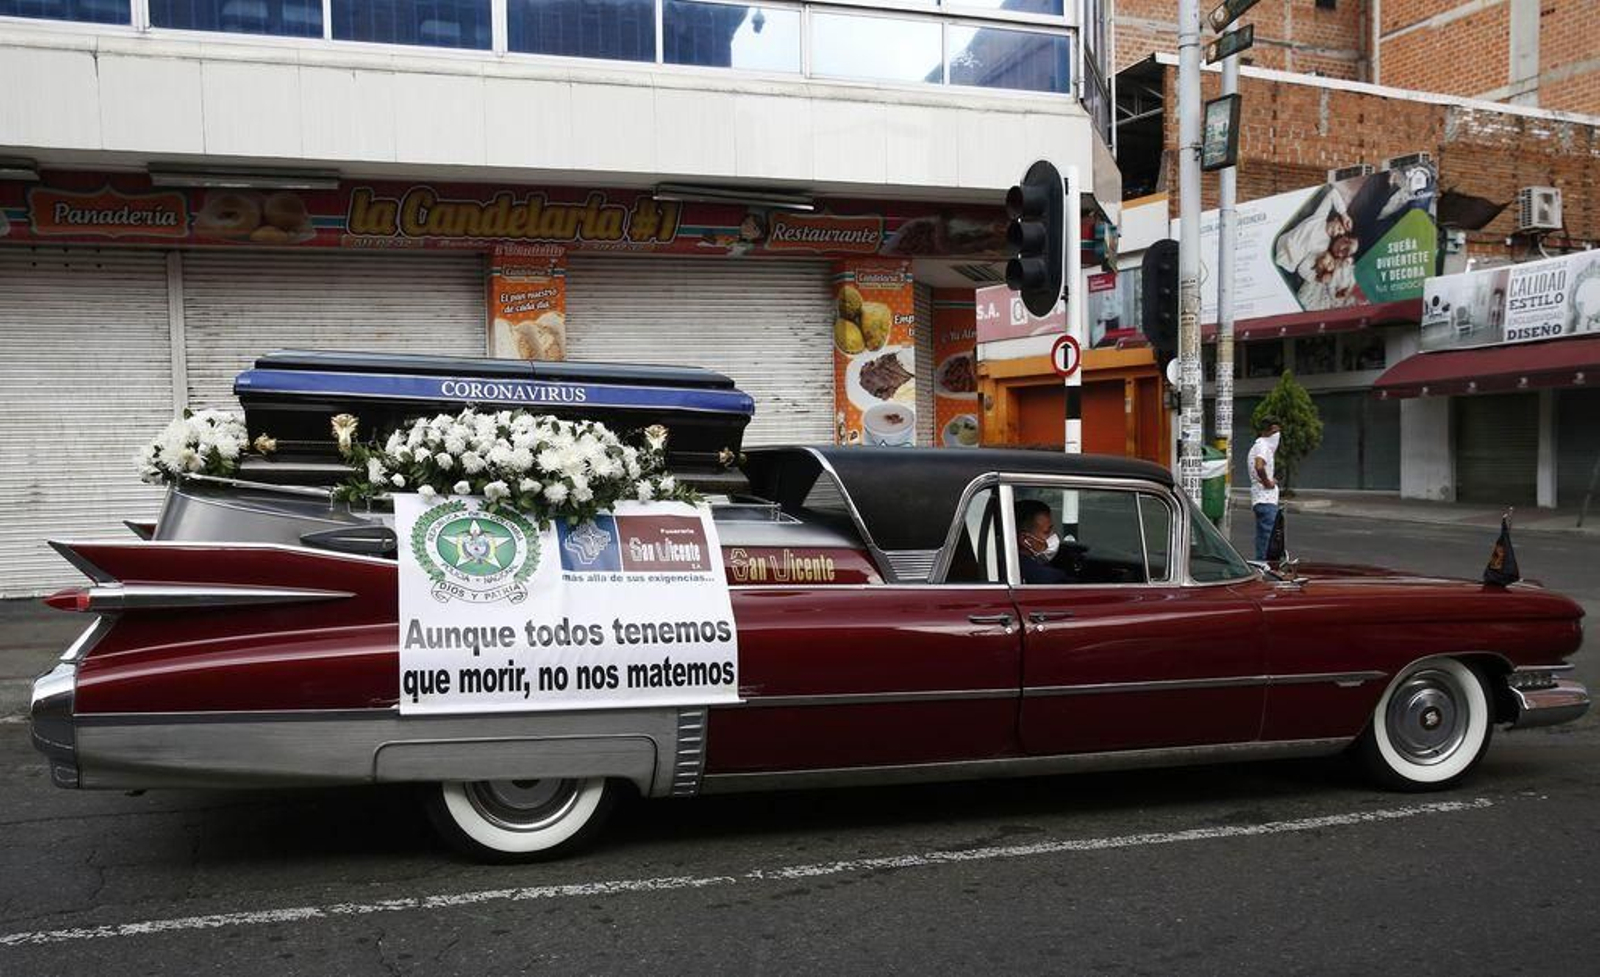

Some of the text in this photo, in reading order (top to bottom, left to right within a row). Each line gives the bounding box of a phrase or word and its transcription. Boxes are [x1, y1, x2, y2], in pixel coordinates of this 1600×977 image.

[54, 202, 178, 226] Panadería
[402, 187, 626, 241] Candelaria
[772, 222, 880, 245] Restaurante
[1387, 237, 1417, 254] SUEÑA
[1381, 265, 1425, 282] Y DECORA
[1510, 269, 1567, 299] CALIDAD
[500, 293, 509, 302] El
[1509, 291, 1565, 310] ESTILO
[1507, 322, 1562, 341] DISEÑO
[441, 380, 586, 402] CORONAVIRUS
[629, 537, 701, 562] San Vicente
[731, 548, 835, 581] San Vicente
[610, 573, 623, 582] de
[626, 574, 645, 583] sus
[440, 582, 464, 598] DIOS
[484, 583, 521, 600] PATRIA
[404, 617, 732, 656] Aunque todos tenemos
[403, 656, 735, 703] que morir, no nos matemos
